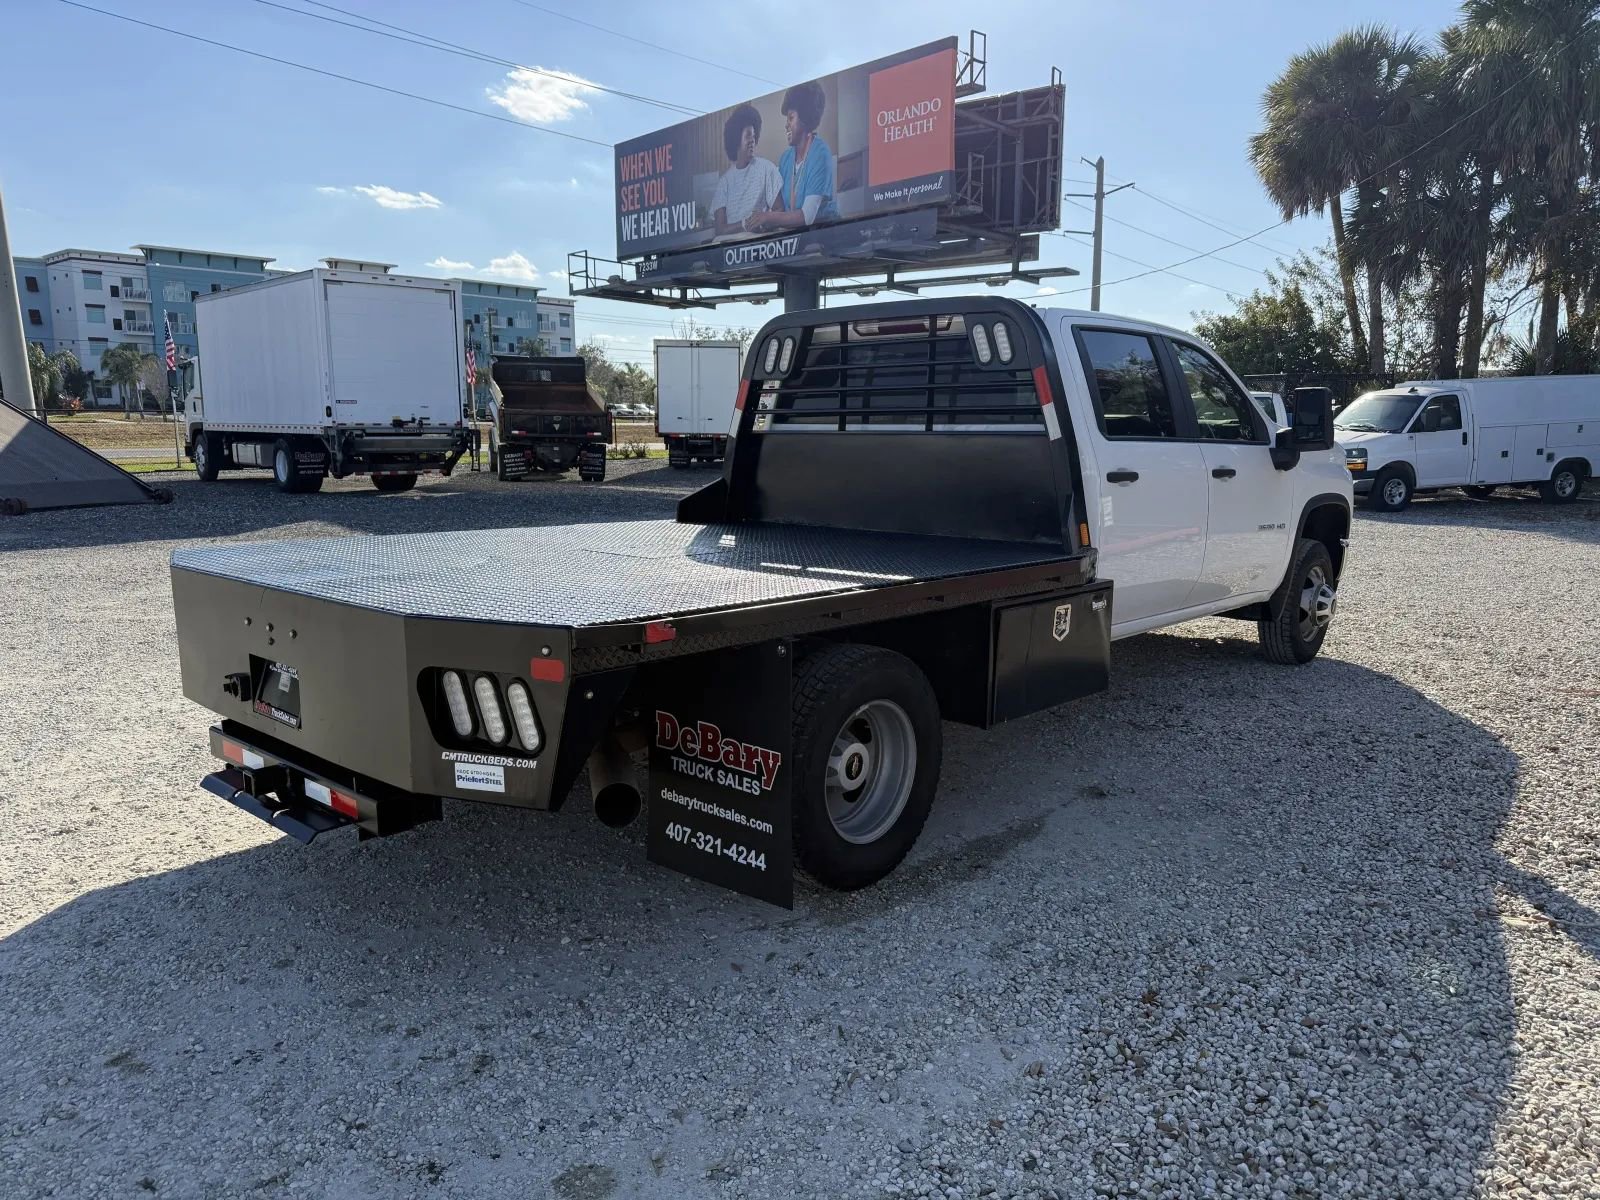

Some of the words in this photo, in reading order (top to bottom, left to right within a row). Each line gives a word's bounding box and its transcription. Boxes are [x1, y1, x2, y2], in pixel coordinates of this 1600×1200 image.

[877, 97, 942, 127] ORLANDO
[884, 117, 934, 143] HEALTH
[620, 149, 653, 182] WHEN
[655, 143, 673, 174] WE
[621, 183, 640, 213] SEE
[643, 177, 669, 208] YOU,
[873, 192, 884, 202] We
[885, 189, 902, 199] Make
[903, 187, 909, 196] It
[907, 175, 944, 203] personal
[621, 213, 638, 242] WE
[640, 207, 670, 239] HEAR
[672, 200, 699, 233] YOU.
[441, 751, 538, 770] CMTRUCKBEDS.COM
[656, 709, 782, 791] DeBary
[671, 755, 714, 783] TRUCK
[717, 769, 761, 796] SALES
[660, 787, 773, 835] debarytrucksales.com
[665, 821, 767, 872] 407-321-4244
